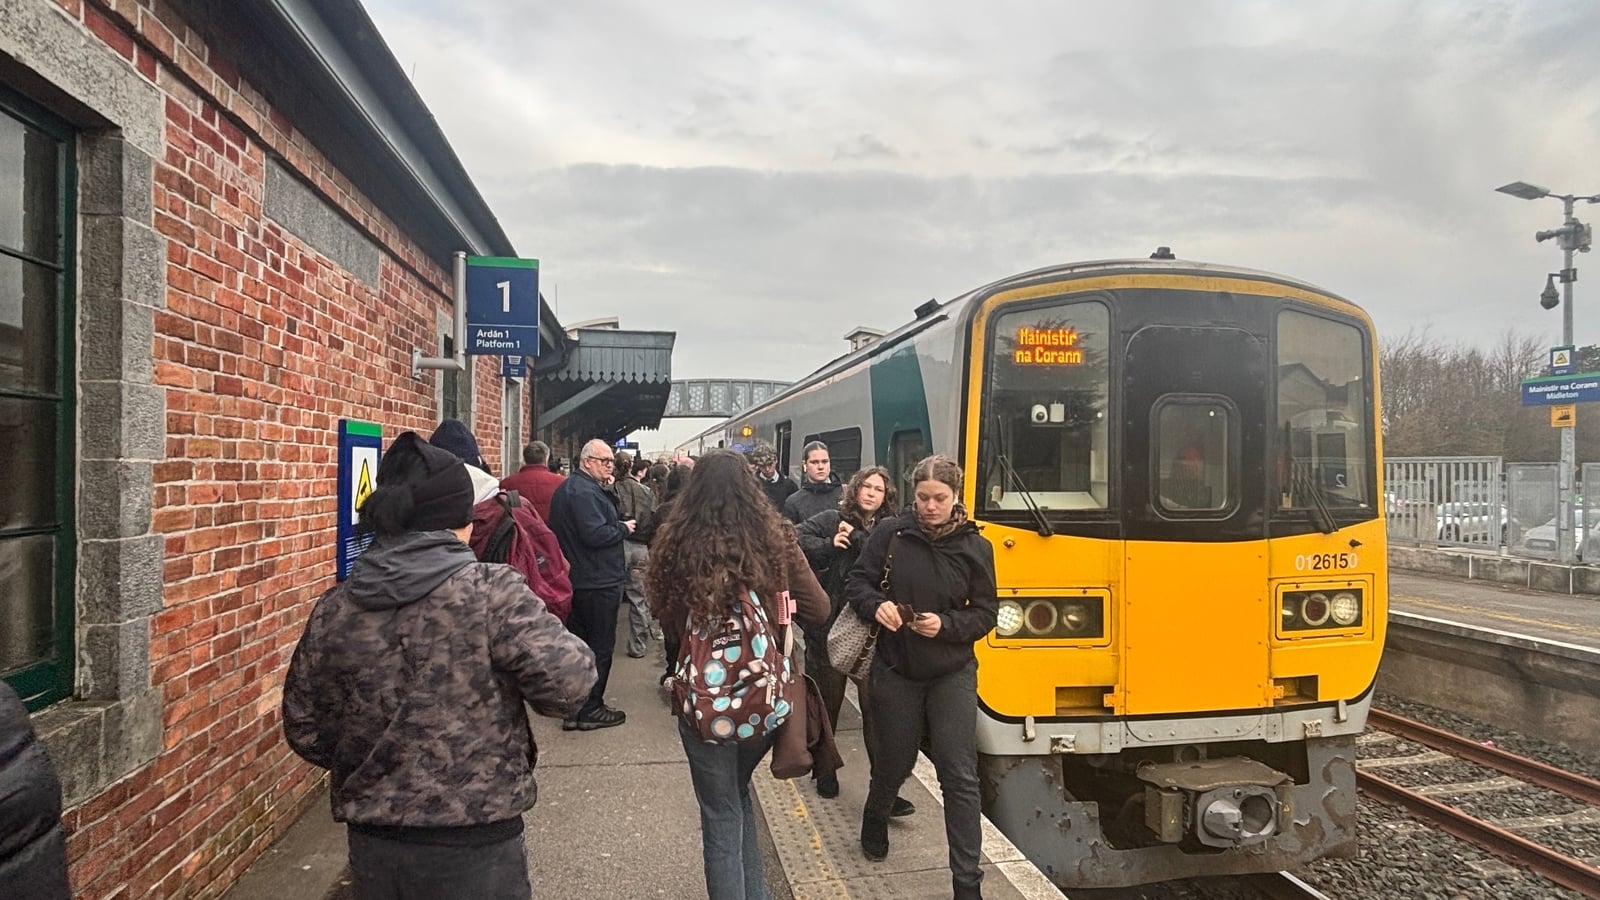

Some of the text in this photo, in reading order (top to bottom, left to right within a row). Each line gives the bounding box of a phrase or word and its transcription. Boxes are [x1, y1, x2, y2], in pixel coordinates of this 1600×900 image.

[497, 280, 510, 313] 1
[476, 328, 509, 338] Ardán 1
[1020, 327, 1078, 346] Mainistir
[476, 339, 520, 348] Platform 1
[1015, 346, 1081, 364] na Corann
[1529, 385, 1559, 393] Mainistir
[1570, 382, 1598, 390] Corann
[1546, 391, 1579, 400] Midleton
